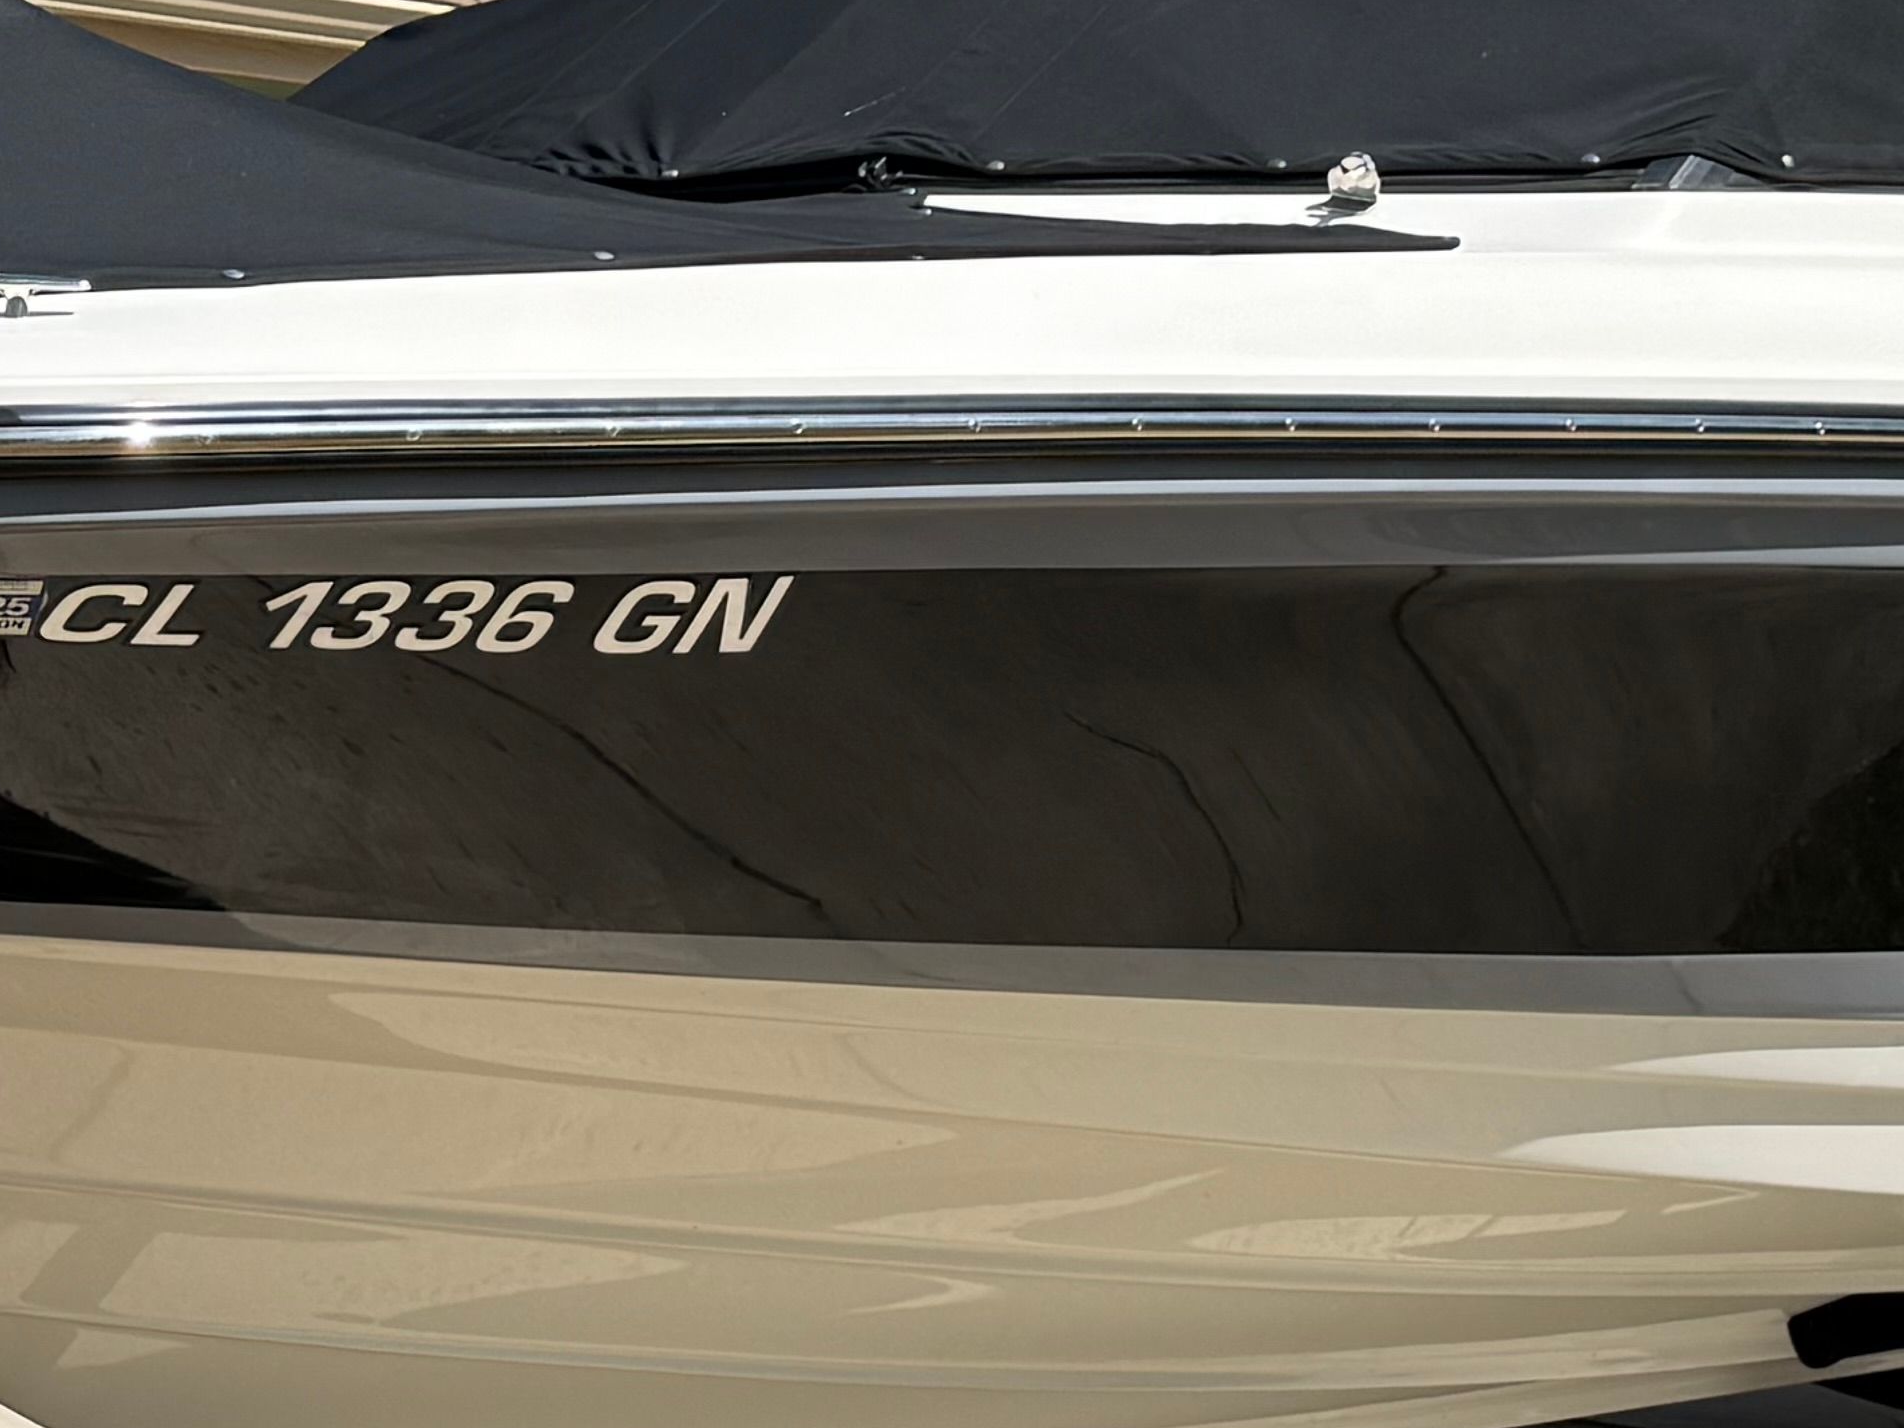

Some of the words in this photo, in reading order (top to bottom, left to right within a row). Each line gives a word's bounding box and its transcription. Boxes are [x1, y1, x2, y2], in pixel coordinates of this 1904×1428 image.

[38, 582, 202, 649] CL
[264, 580, 571, 654] 1336
[592, 575, 795, 655] GN
